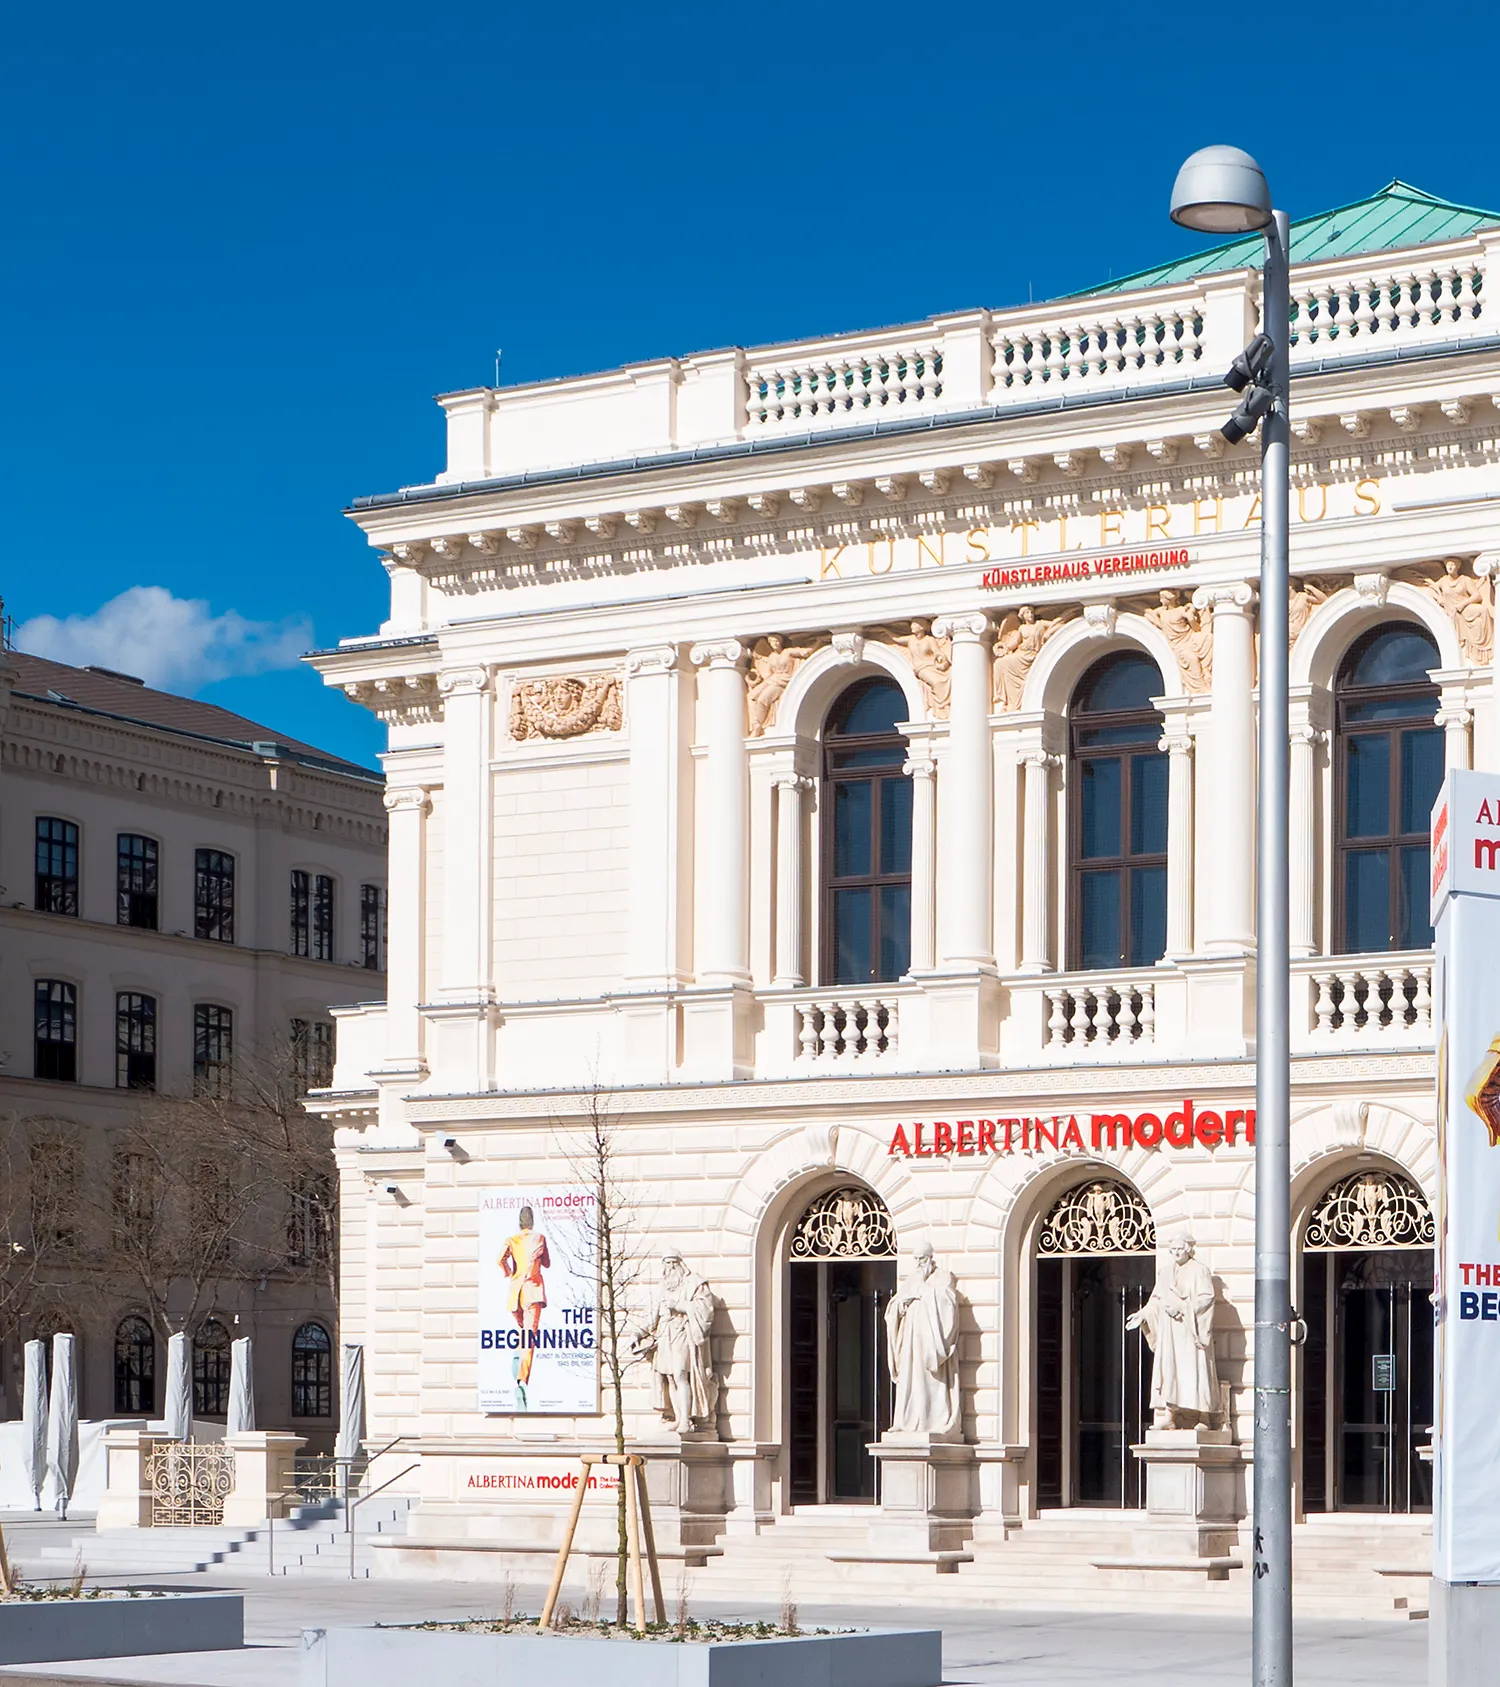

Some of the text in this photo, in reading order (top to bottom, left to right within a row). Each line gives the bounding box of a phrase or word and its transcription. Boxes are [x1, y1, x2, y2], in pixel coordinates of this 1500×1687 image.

[982, 549, 1189, 587] KÜNSTLERHAUS VEREINIGUNG
[888, 1115, 1085, 1156] ALBERTINA
[483, 1193, 595, 1209] ALBERTINA modern
[562, 1309, 593, 1324] THE
[481, 1328, 594, 1349] BEGINNING
[467, 1472, 597, 1489] ALBERTINA moden
